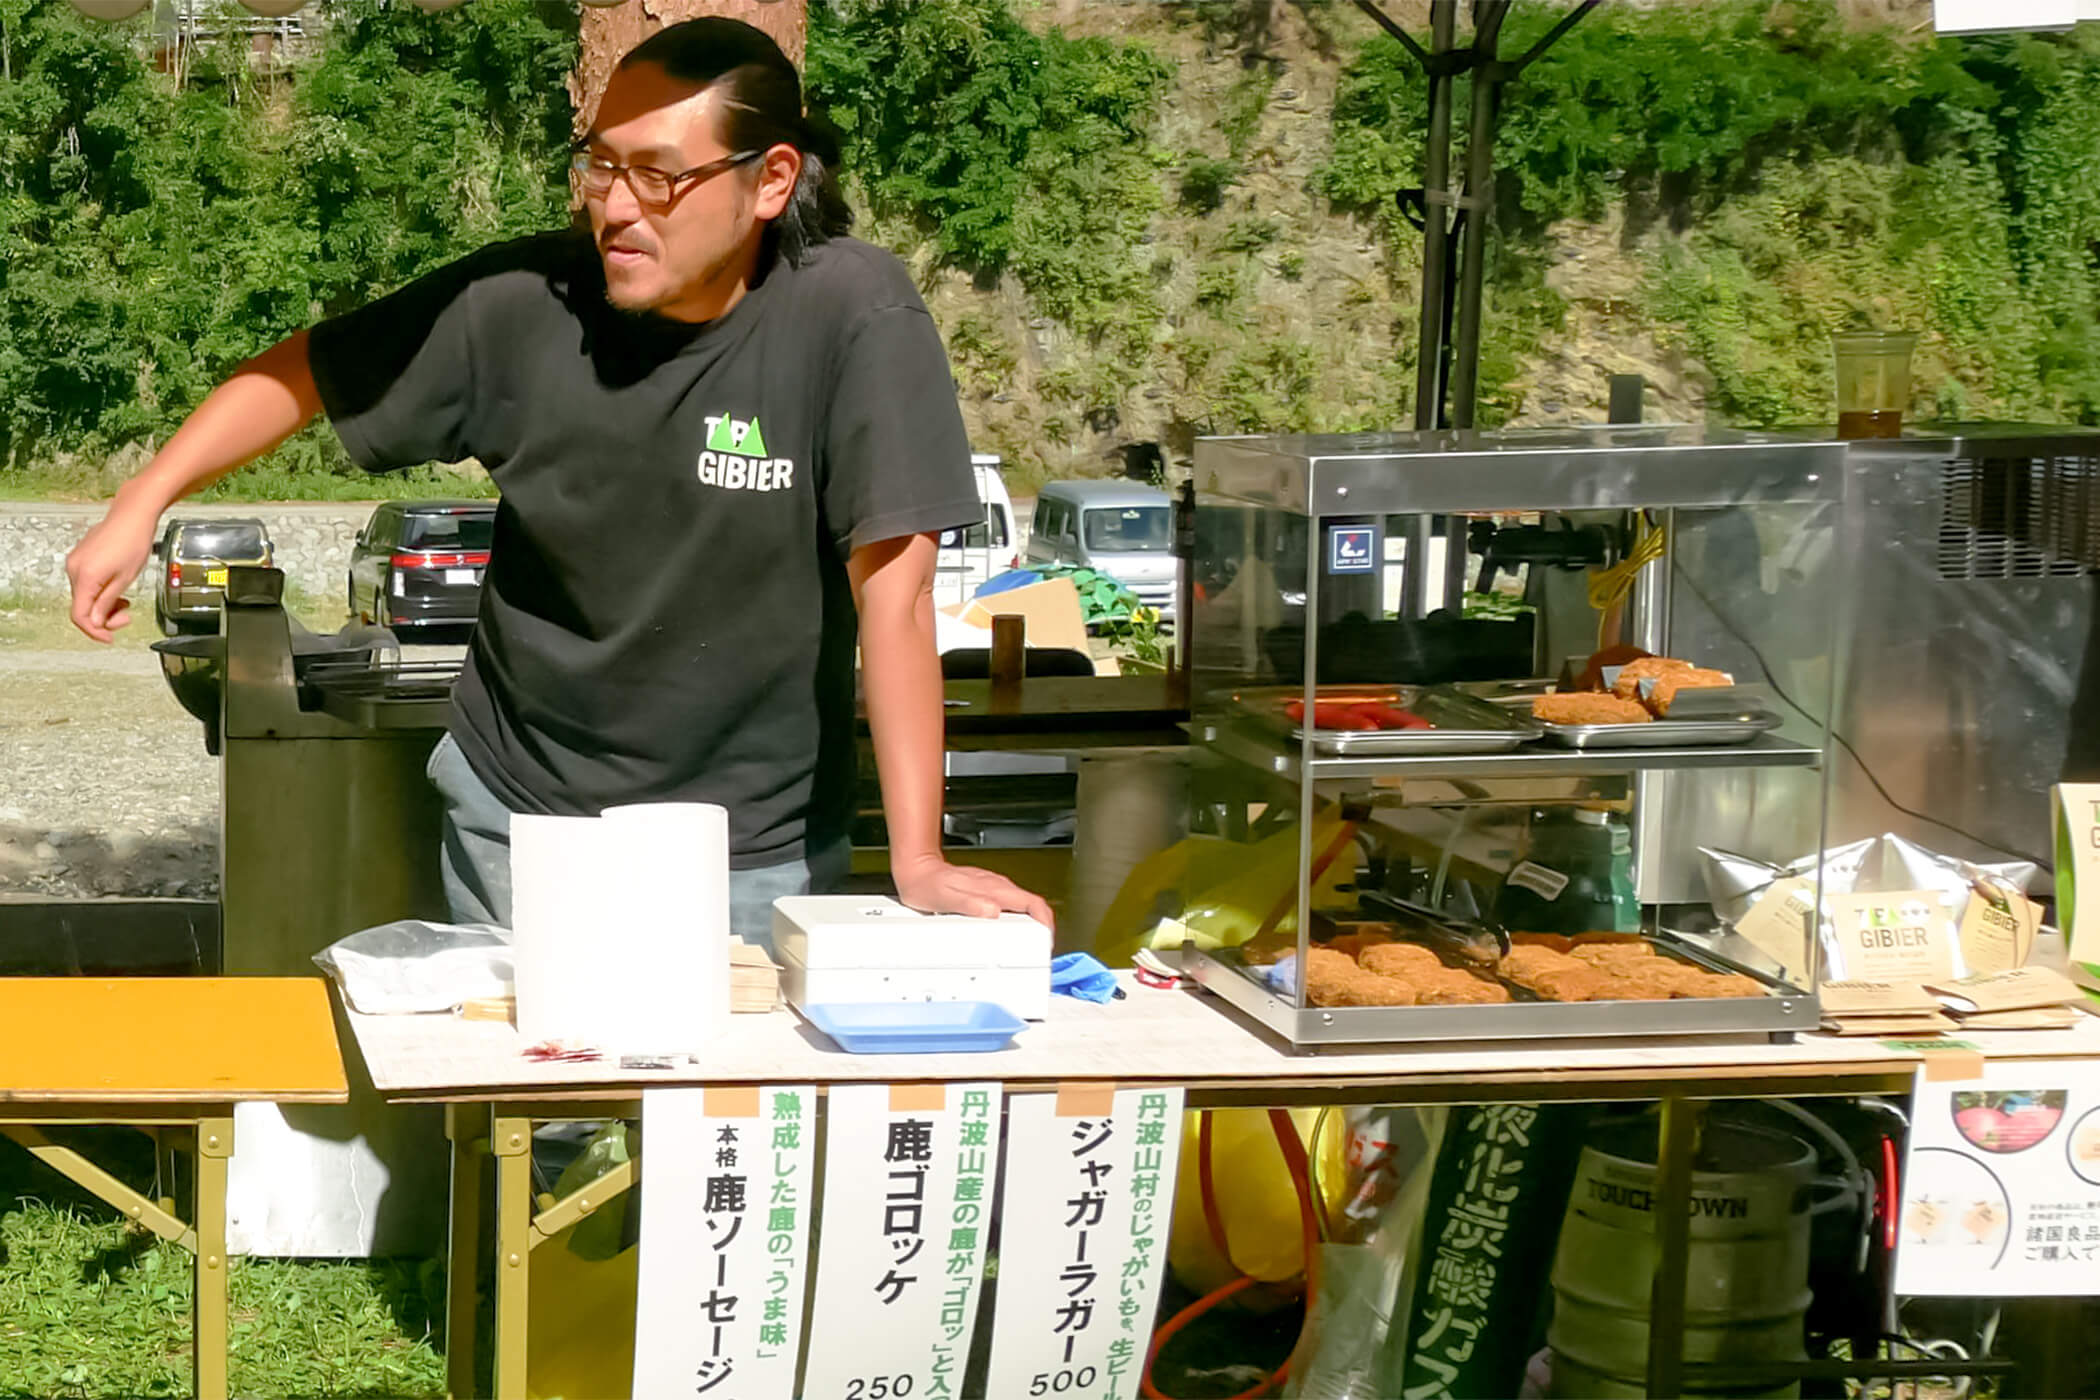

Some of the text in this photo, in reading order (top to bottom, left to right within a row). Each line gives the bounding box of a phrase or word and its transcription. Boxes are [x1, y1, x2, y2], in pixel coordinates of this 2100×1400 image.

[697, 450, 794, 493] GIBIER
[1860, 926, 1929, 949] GIBIER
[1982, 906, 2021, 934] GIBIER
[756, 1090, 803, 1359] 熟成した鹿の「うま味」
[873, 1118, 934, 1305] 鹿ゴロッケ
[1052, 1117, 1114, 1364] ジャガーラガー
[845, 1373, 914, 1400] 250
[1029, 1365, 1097, 1397] 500
